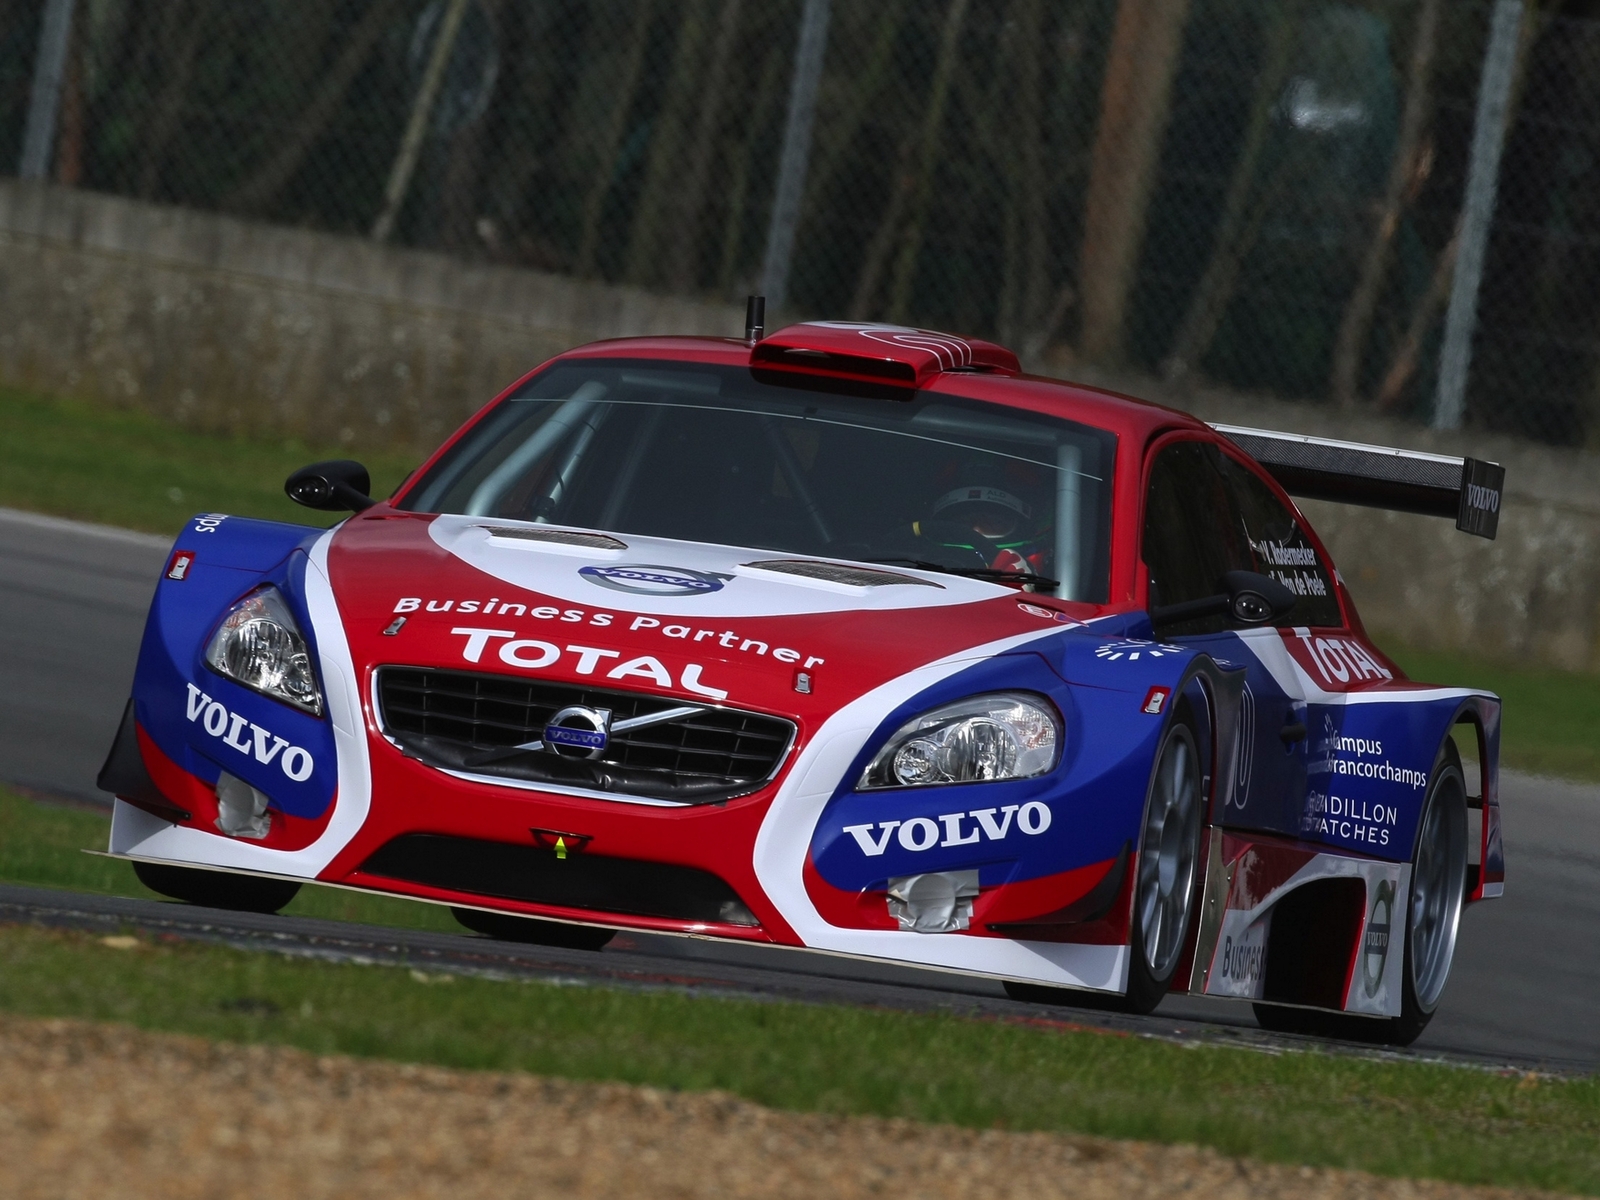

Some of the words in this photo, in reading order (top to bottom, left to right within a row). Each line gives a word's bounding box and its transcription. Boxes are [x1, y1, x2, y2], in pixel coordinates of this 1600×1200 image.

[1467, 483, 1499, 514] VOLVO
[592, 569, 711, 588] VOLVO
[393, 597, 612, 627] Business
[629, 616, 825, 669] Partner
[1291, 626, 1394, 684] TOTAL
[450, 627, 729, 699] TOTAL
[186, 683, 314, 782] VOLVO
[549, 728, 602, 746] VOLVO
[842, 801, 1052, 857] VOLVO
[1366, 931, 1388, 947] VOLVO
